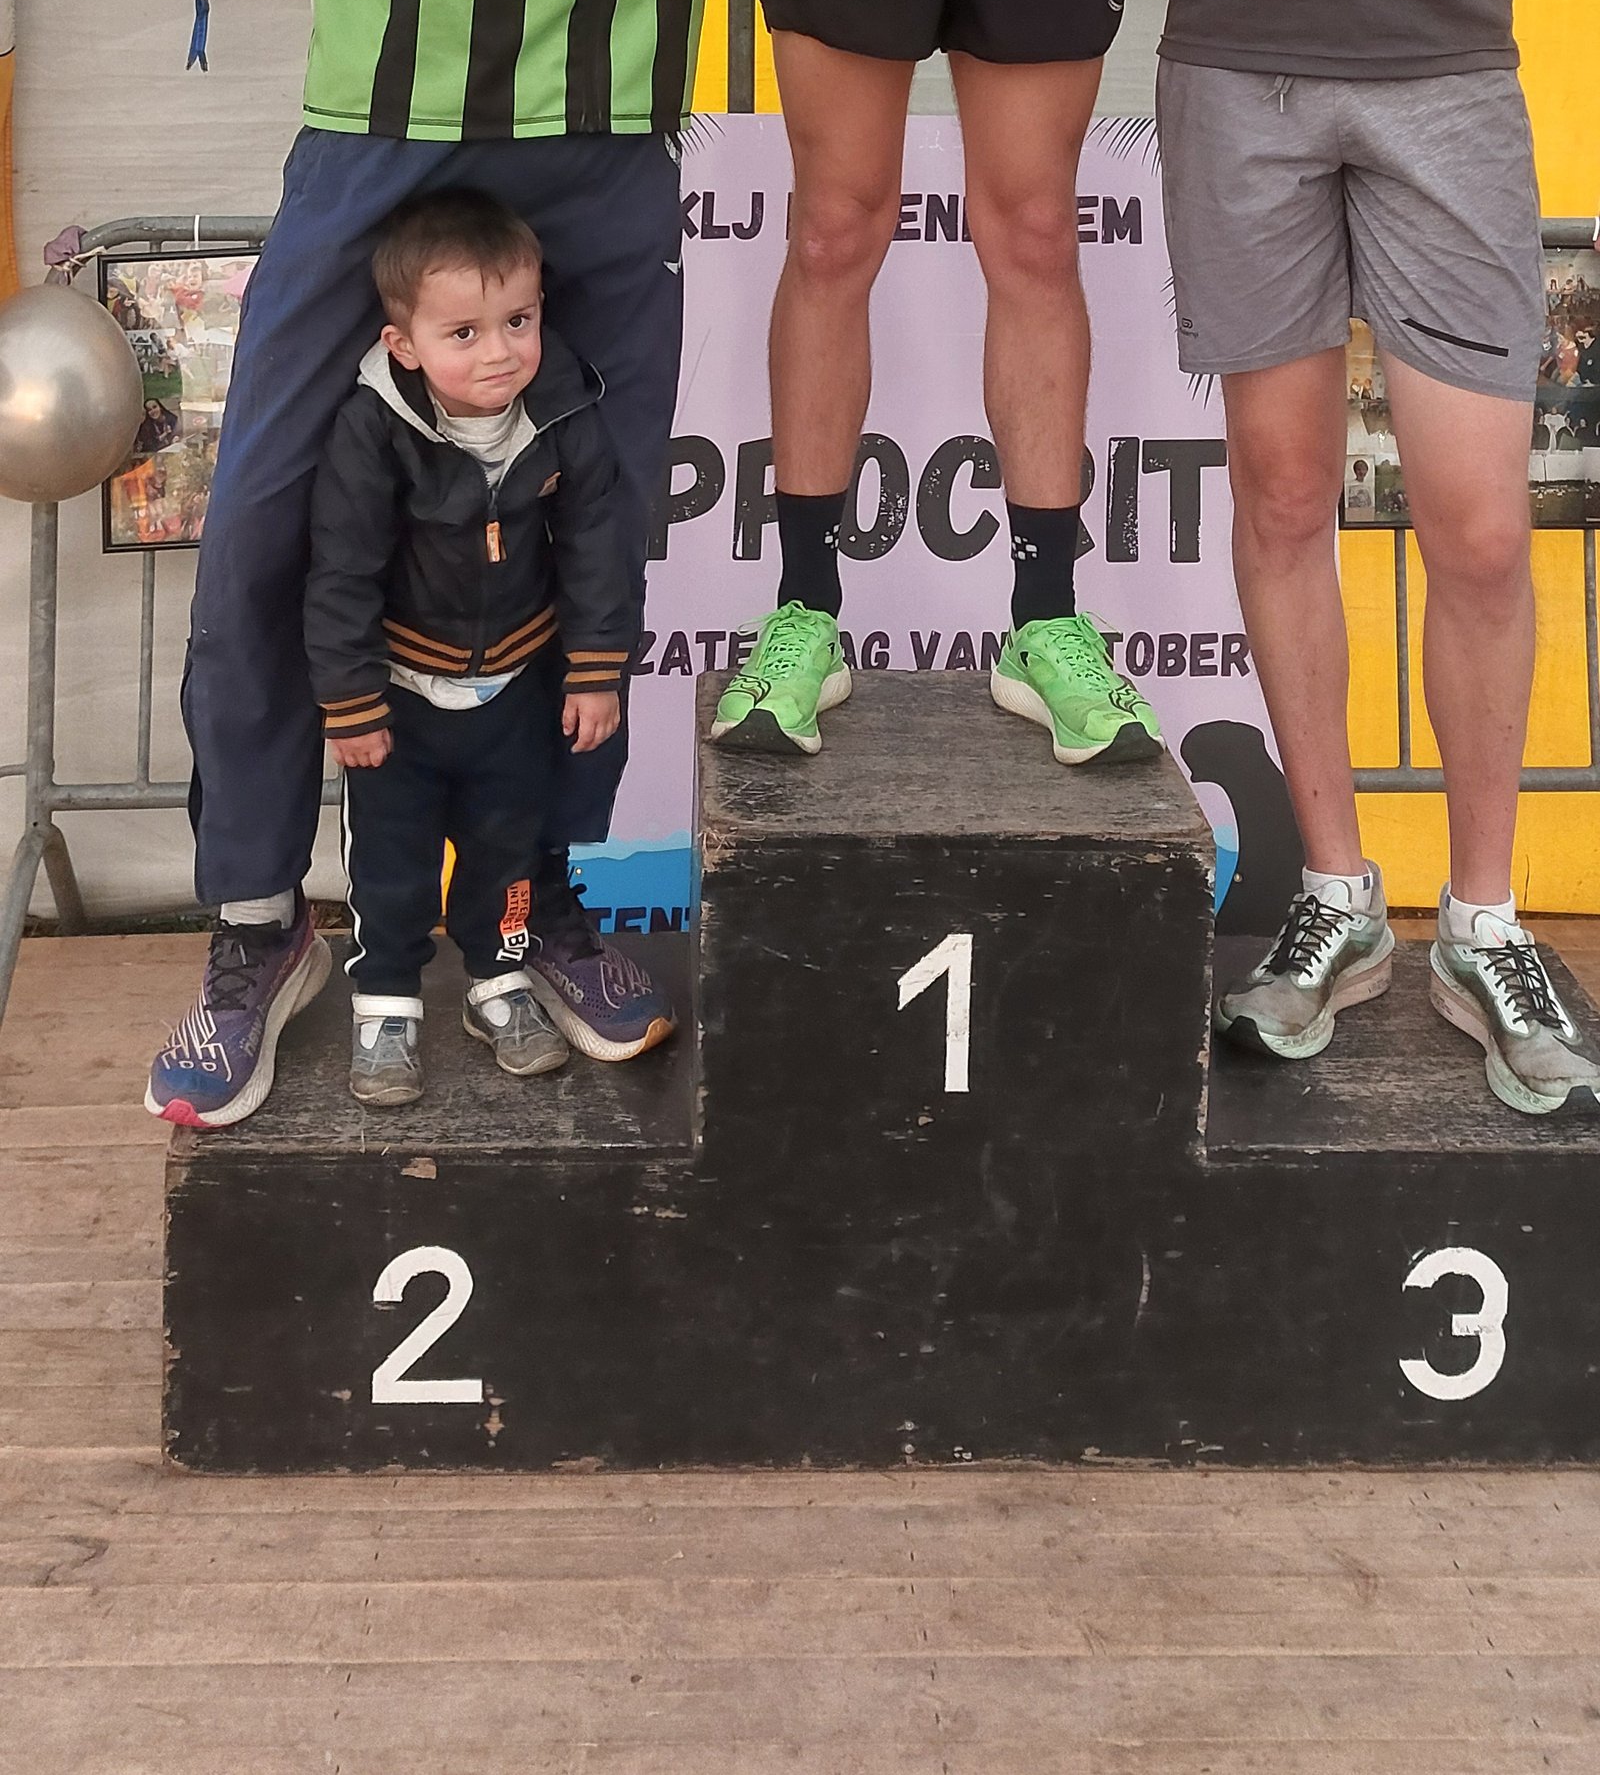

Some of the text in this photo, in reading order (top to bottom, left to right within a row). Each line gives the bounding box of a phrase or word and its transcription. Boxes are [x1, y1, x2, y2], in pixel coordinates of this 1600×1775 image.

[680, 191, 764, 239] KLJ
[910, 631, 1006, 670] VAN
[1106, 632, 1250, 677] TOBER
[897, 933, 974, 1093] 1
[372, 1245, 483, 1403] 2
[1399, 1247, 1509, 1401] 3
